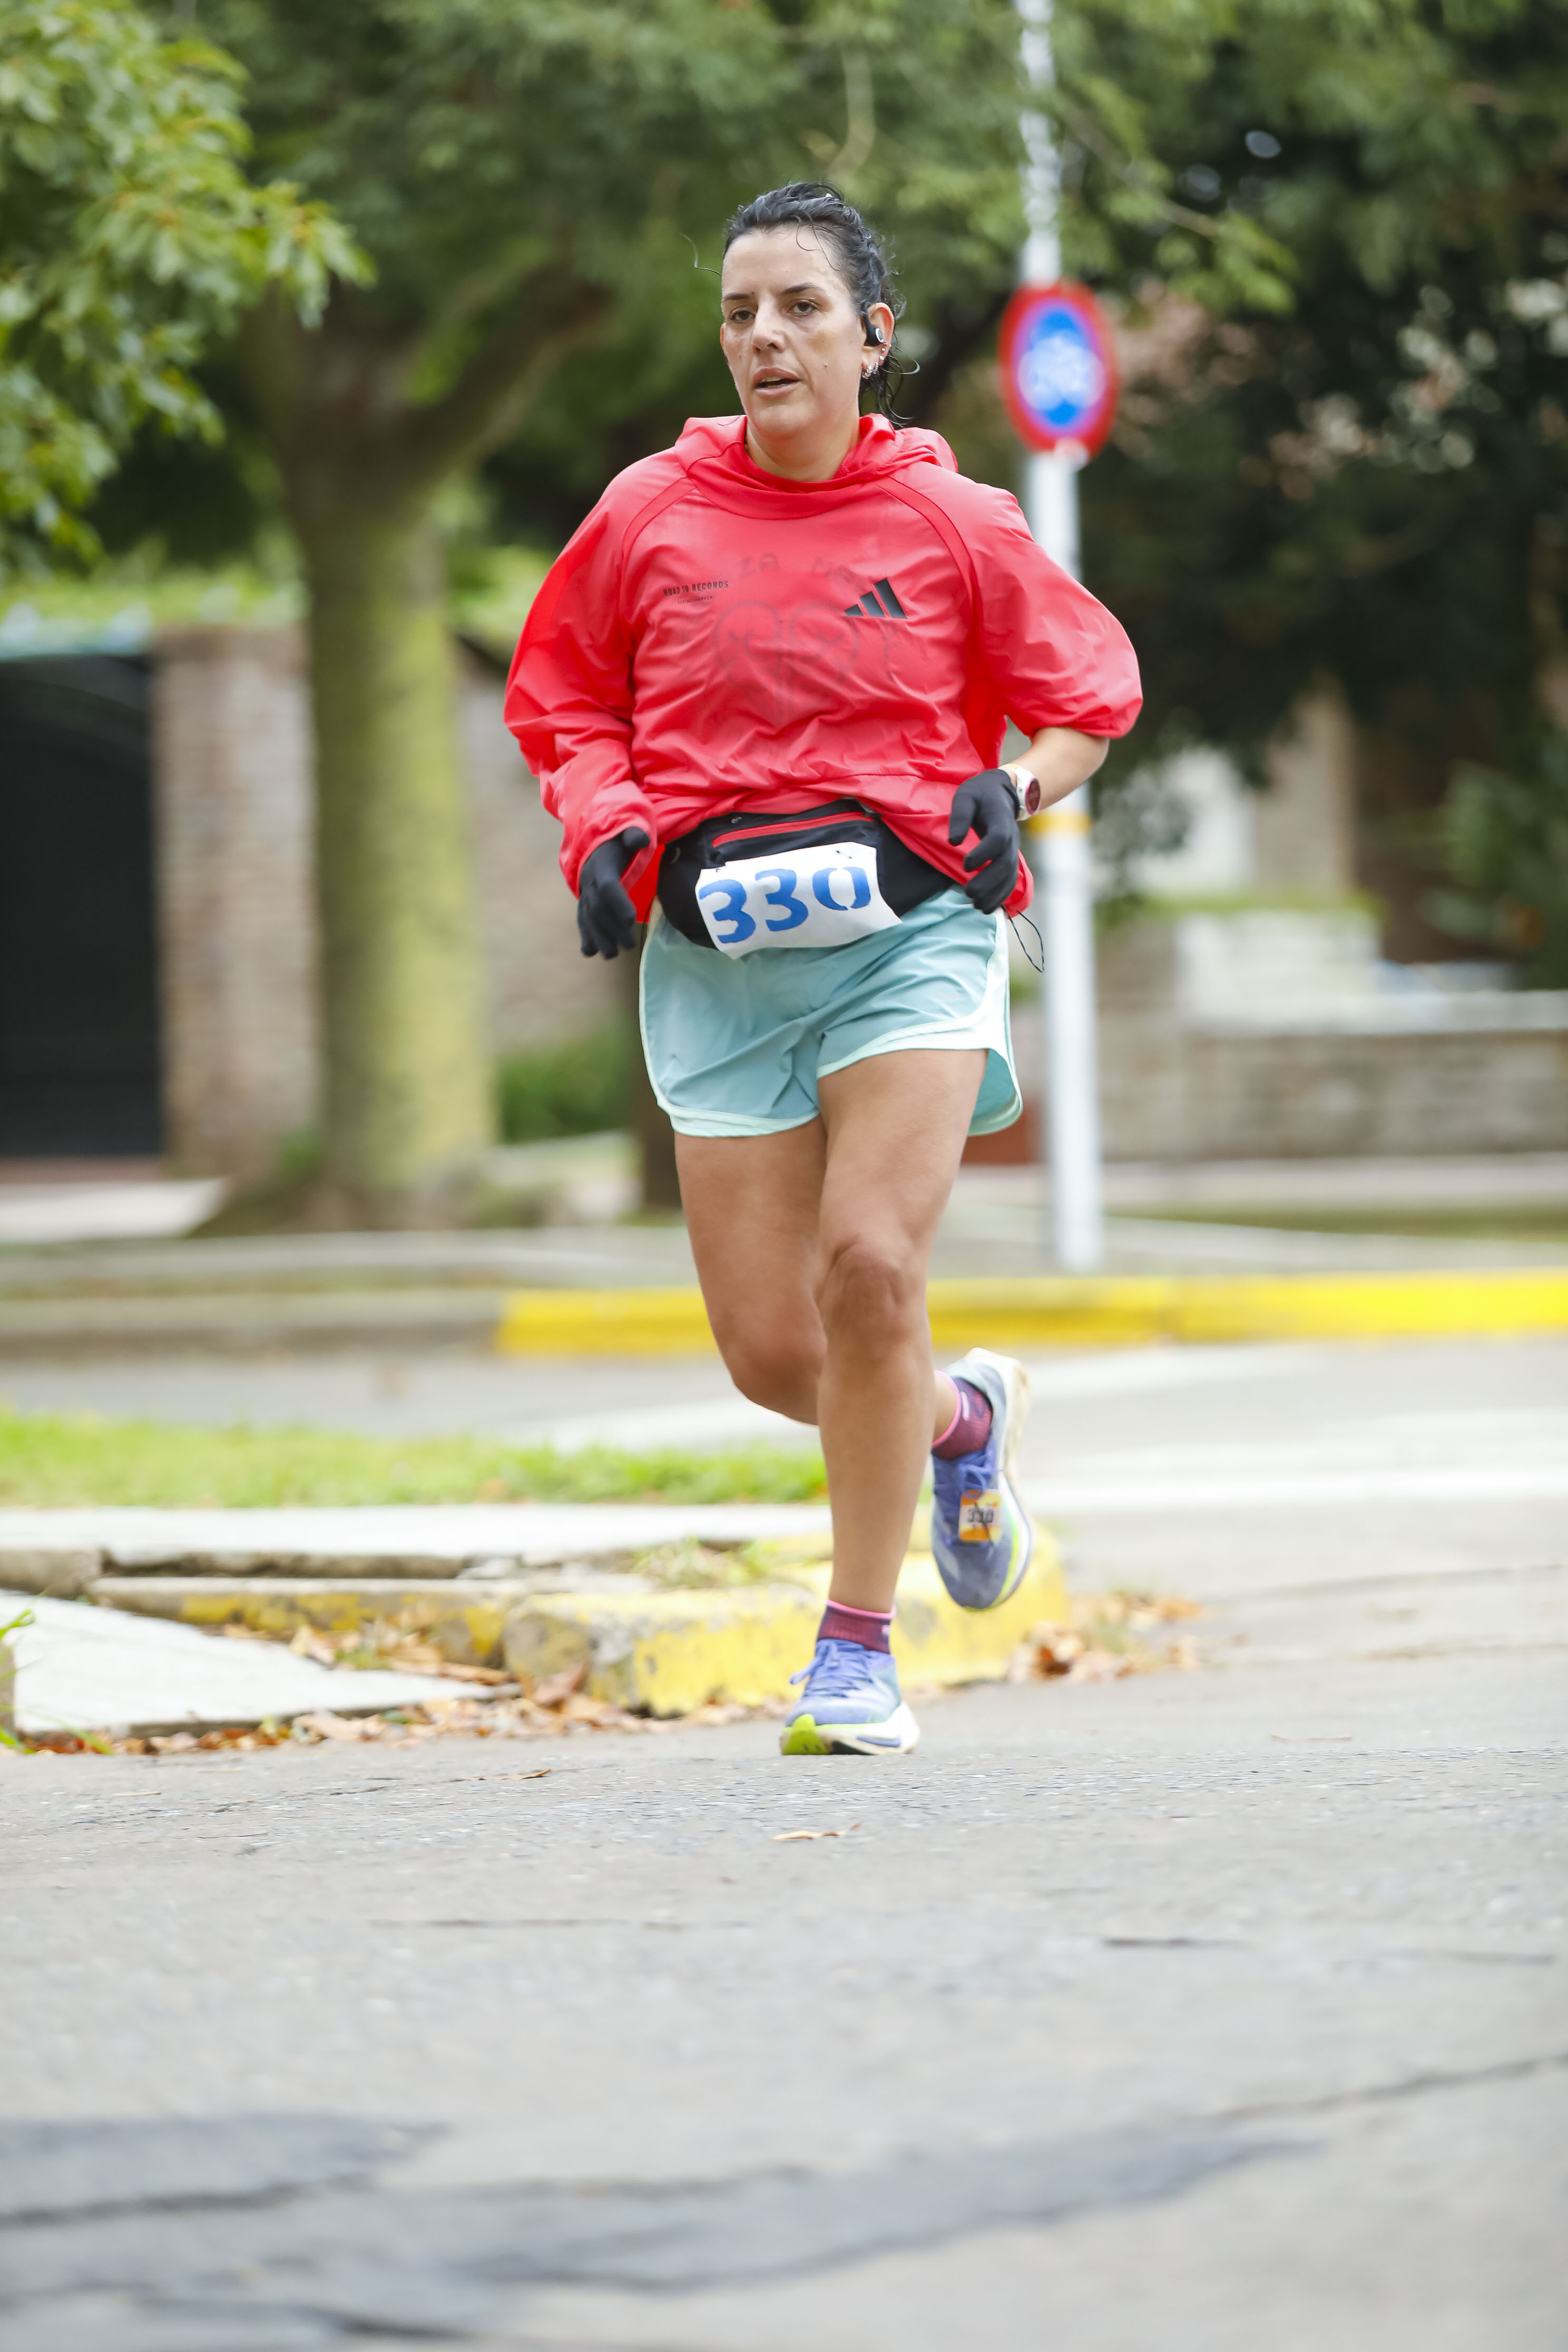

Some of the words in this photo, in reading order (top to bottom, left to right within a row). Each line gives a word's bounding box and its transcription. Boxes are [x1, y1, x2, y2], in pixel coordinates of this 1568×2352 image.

[663, 586, 680, 596] ROAD
[692, 581, 729, 591] RECORDS
[699, 867, 871, 944] 330
